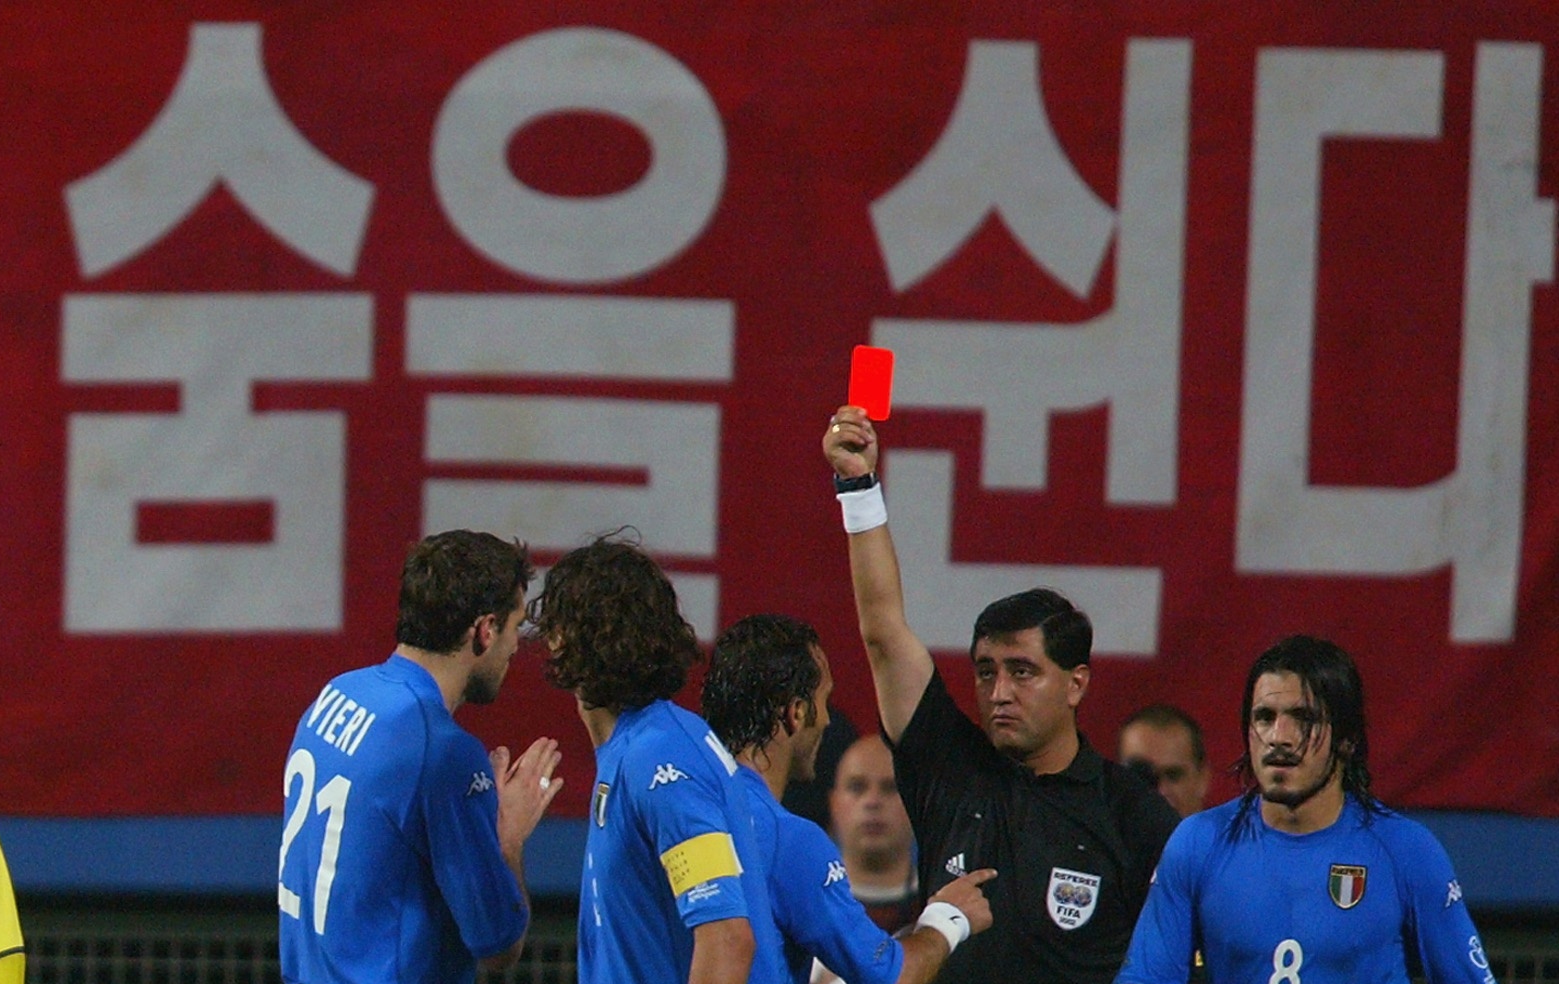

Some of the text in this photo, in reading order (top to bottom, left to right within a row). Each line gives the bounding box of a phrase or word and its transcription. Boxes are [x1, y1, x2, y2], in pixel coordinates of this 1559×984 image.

[59, 20, 735, 643] 숨을
[868, 36, 1557, 658] 쉰다
[305, 683, 376, 757] VIERI
[277, 748, 352, 936] 21
[1056, 905, 1081, 919] FIFA
